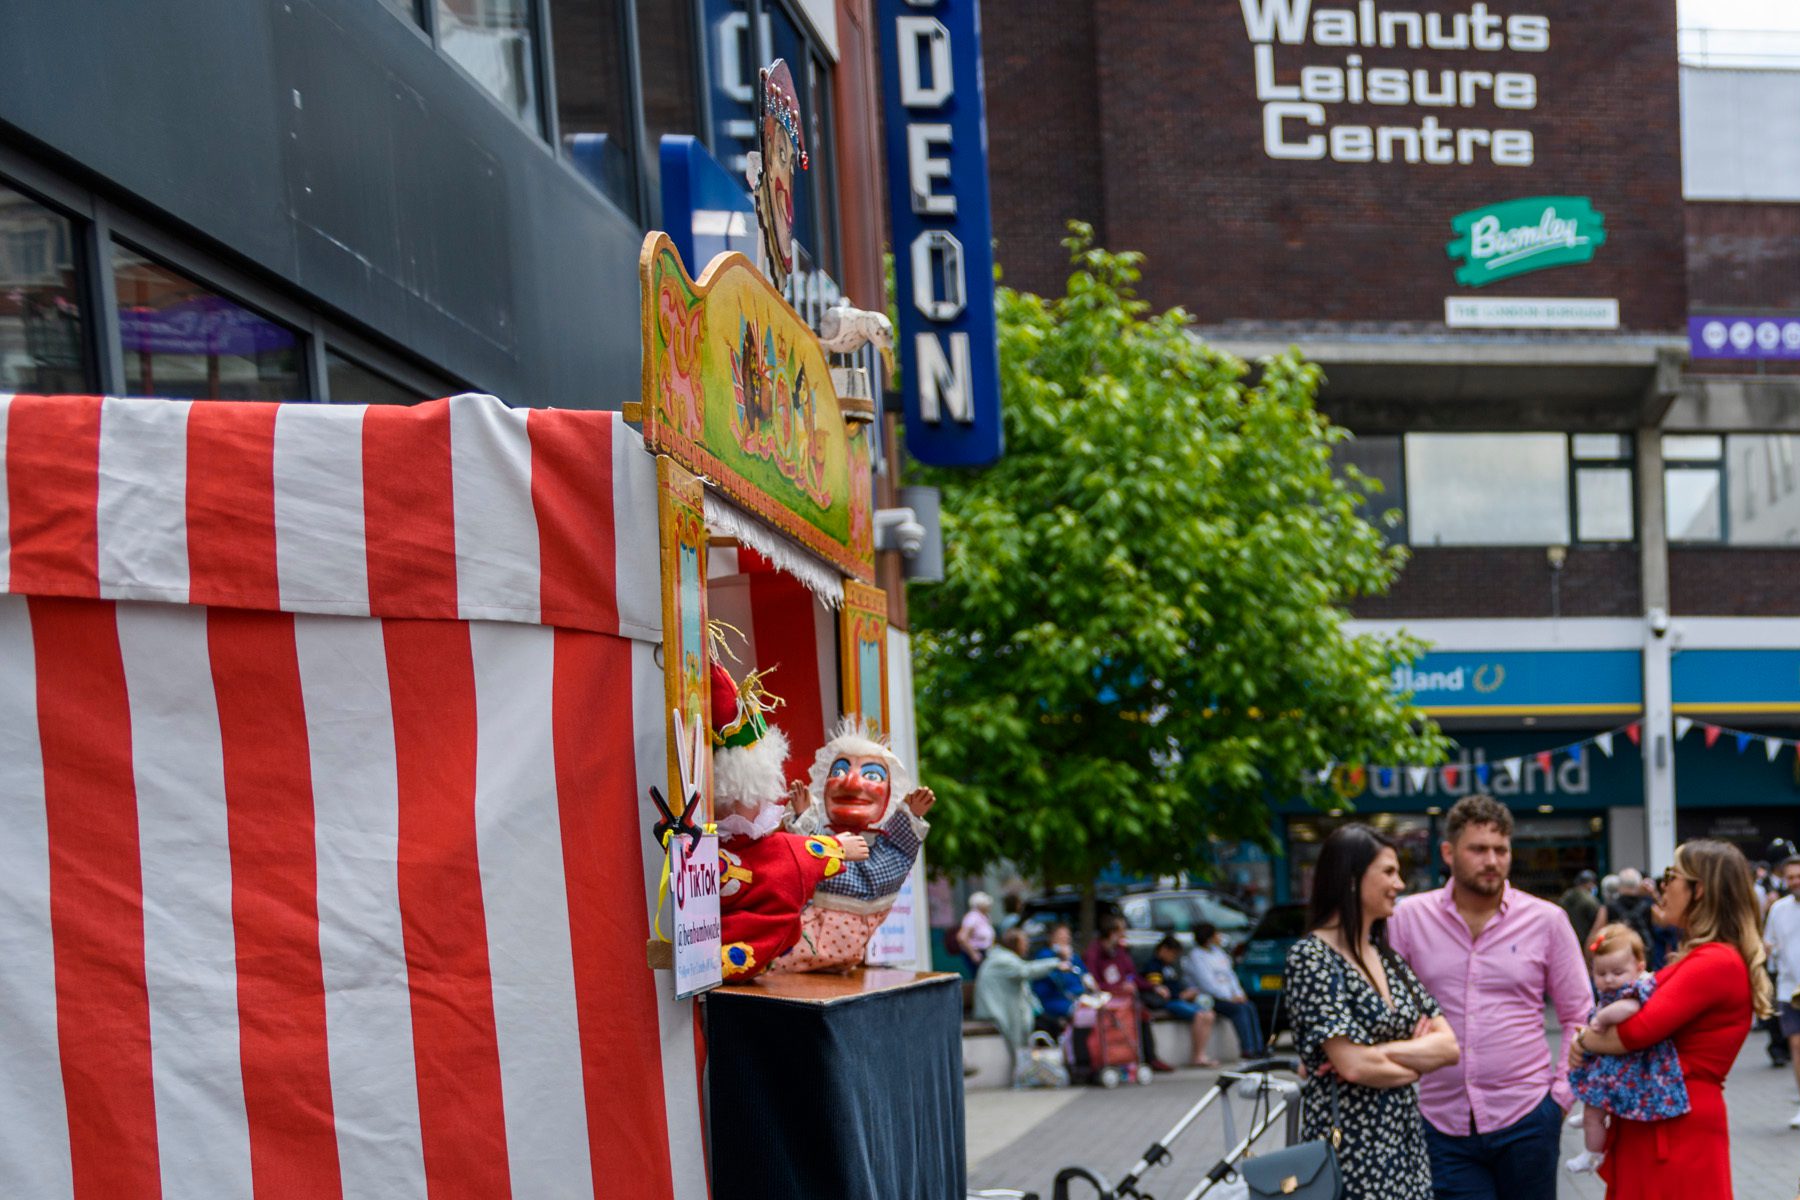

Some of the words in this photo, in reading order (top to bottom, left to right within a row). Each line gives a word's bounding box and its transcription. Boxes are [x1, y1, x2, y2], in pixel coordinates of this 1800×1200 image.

[1239, 0, 1551, 52] Walnuts
[1253, 43, 1538, 109] Leisure
[1262, 101, 1535, 167] Centre
[896, 0, 975, 424] DEON
[1470, 206, 1579, 260] Bromley
[688, 862, 718, 899] TikTok
